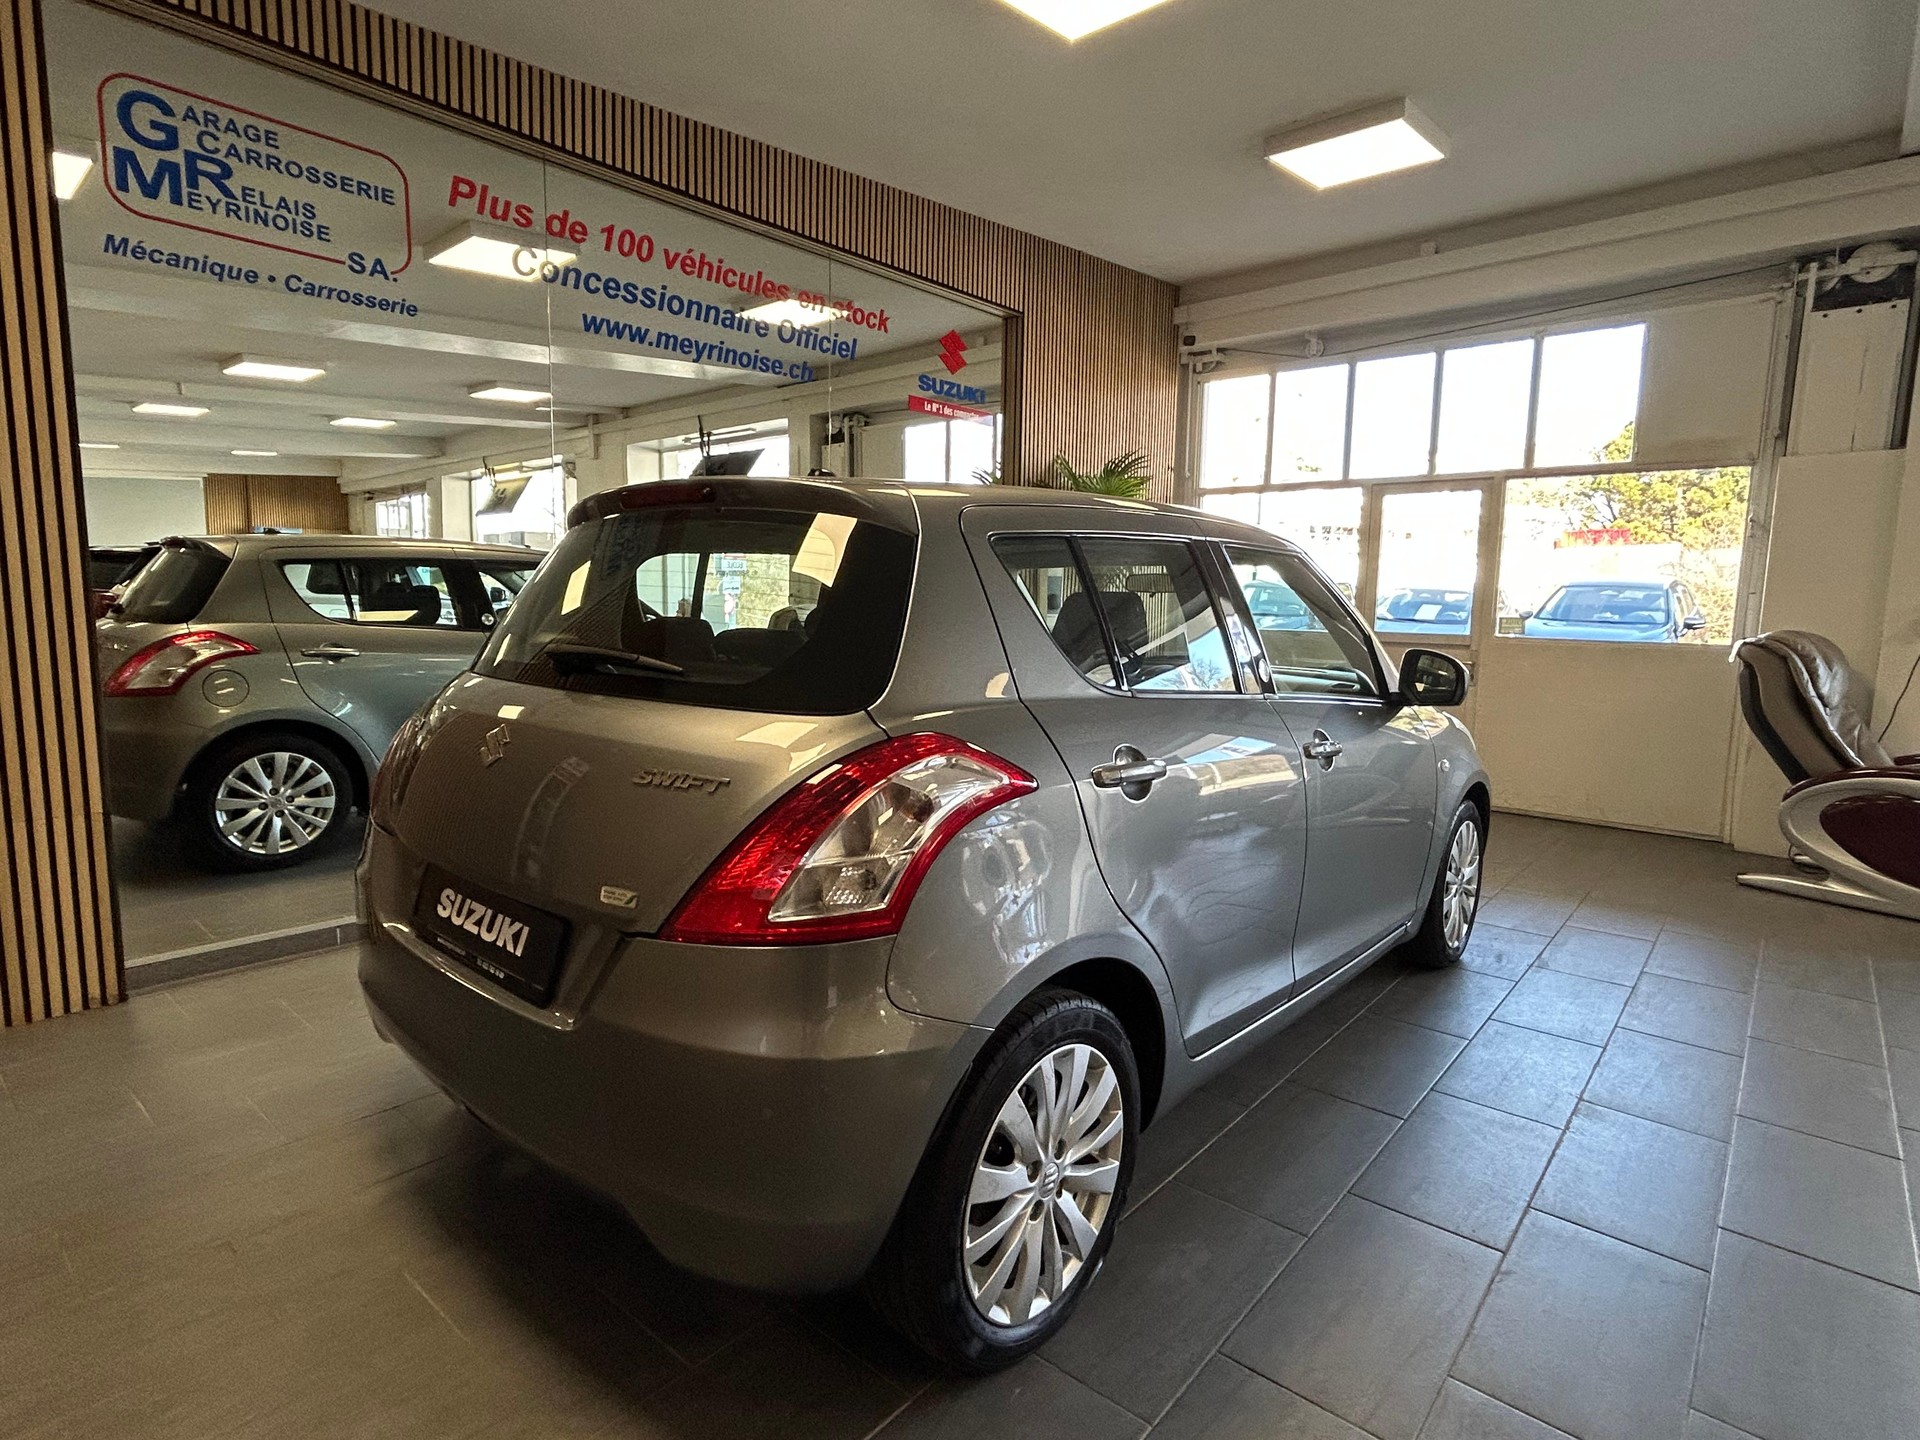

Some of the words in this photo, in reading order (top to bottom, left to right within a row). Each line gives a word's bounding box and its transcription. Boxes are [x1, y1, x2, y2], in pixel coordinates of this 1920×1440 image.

[116, 90, 280, 151] GARAGE
[112, 145, 332, 243] MEYRINOISE
[183, 148, 317, 221] RELAIS
[196, 130, 396, 206] CARROSSERIE
[103, 233, 260, 284] Mécanique
[284, 273, 419, 317] Carrosserie
[347, 251, 399, 282] SA.
[448, 174, 535, 228] Plus
[545, 209, 589, 244] de
[600, 223, 655, 263] 100
[663, 246, 791, 302] véhicules
[798, 290, 826, 313] en
[832, 300, 890, 333] stock
[511, 246, 770, 338] Concessionnaire
[778, 319, 858, 361] Officiel
[581, 312, 815, 383] www.meyrinoise.ch
[918, 374, 985, 404] SUZUKI
[632, 768, 731, 795] SWIFT
[436, 887, 530, 958] SUZUKI
